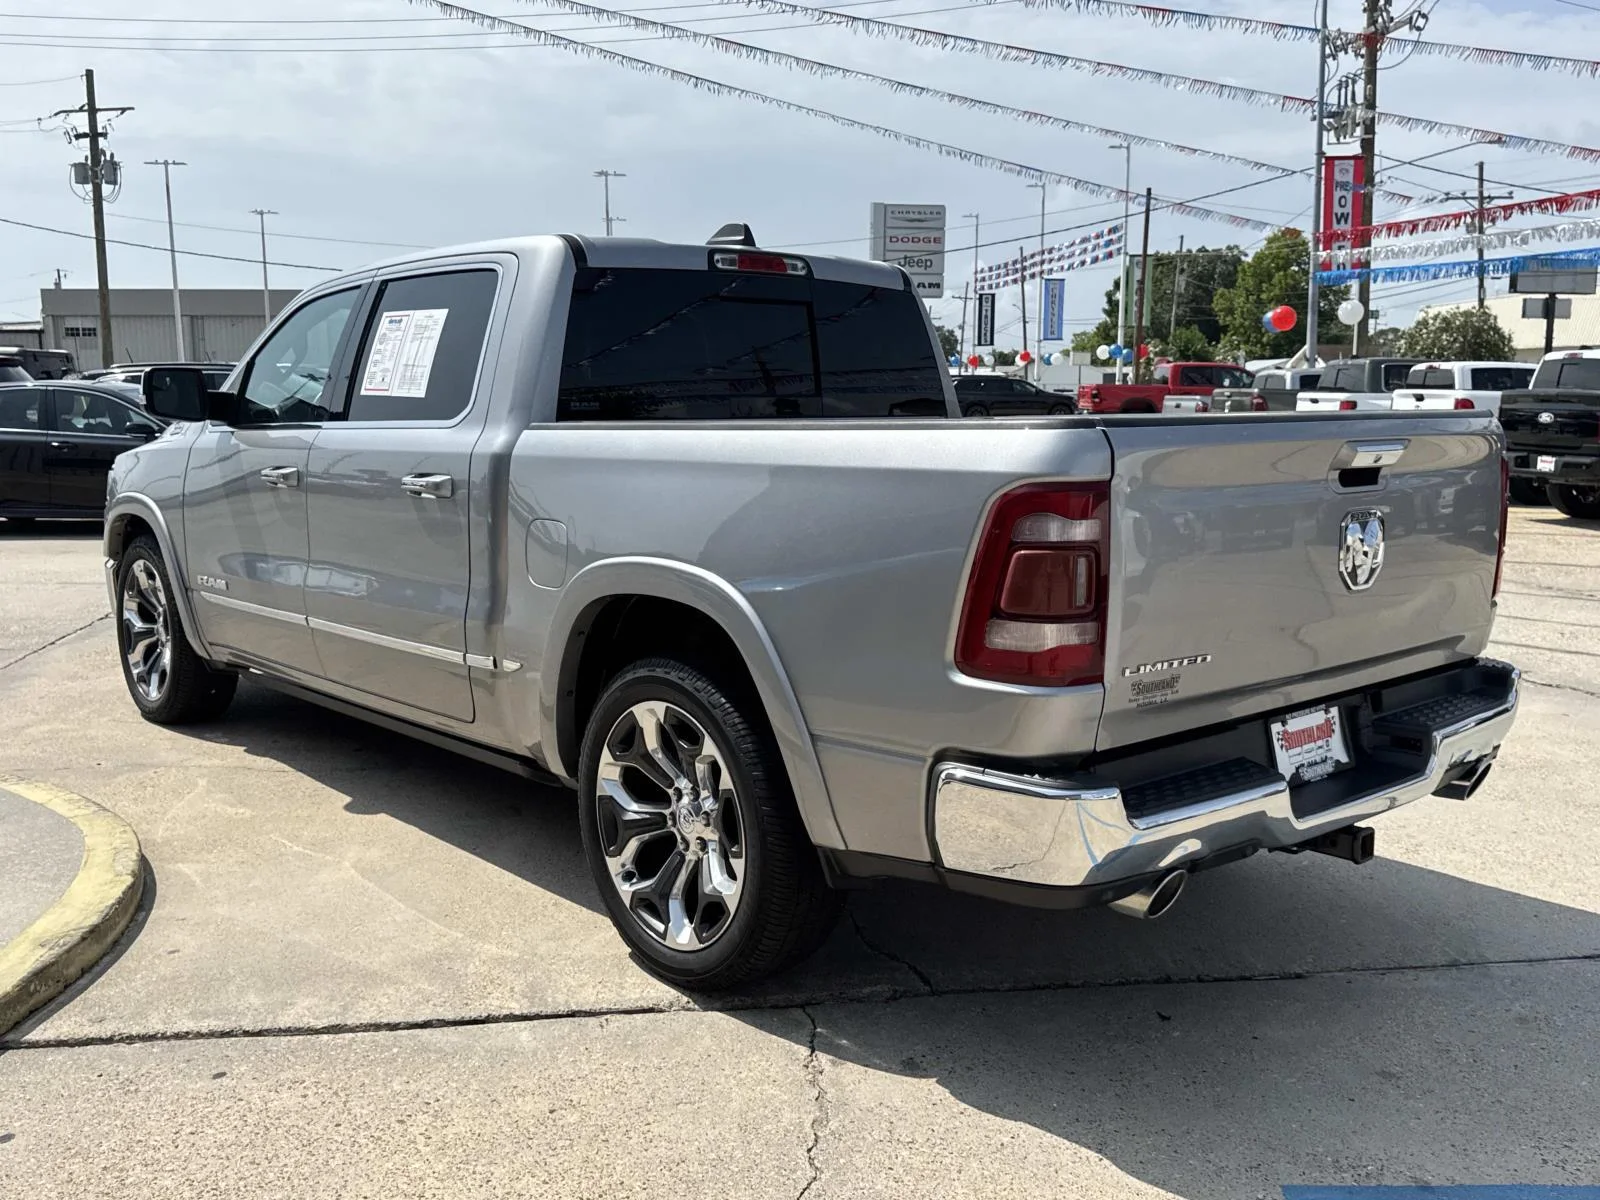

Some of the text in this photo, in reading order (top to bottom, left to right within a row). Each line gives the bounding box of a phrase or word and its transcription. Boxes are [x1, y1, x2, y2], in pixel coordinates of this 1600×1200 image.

[889, 236, 942, 244] DODGE
[898, 255, 933, 270] Jeep
[197, 575, 227, 590] RAM
[1122, 654, 1212, 677] LIMITED
